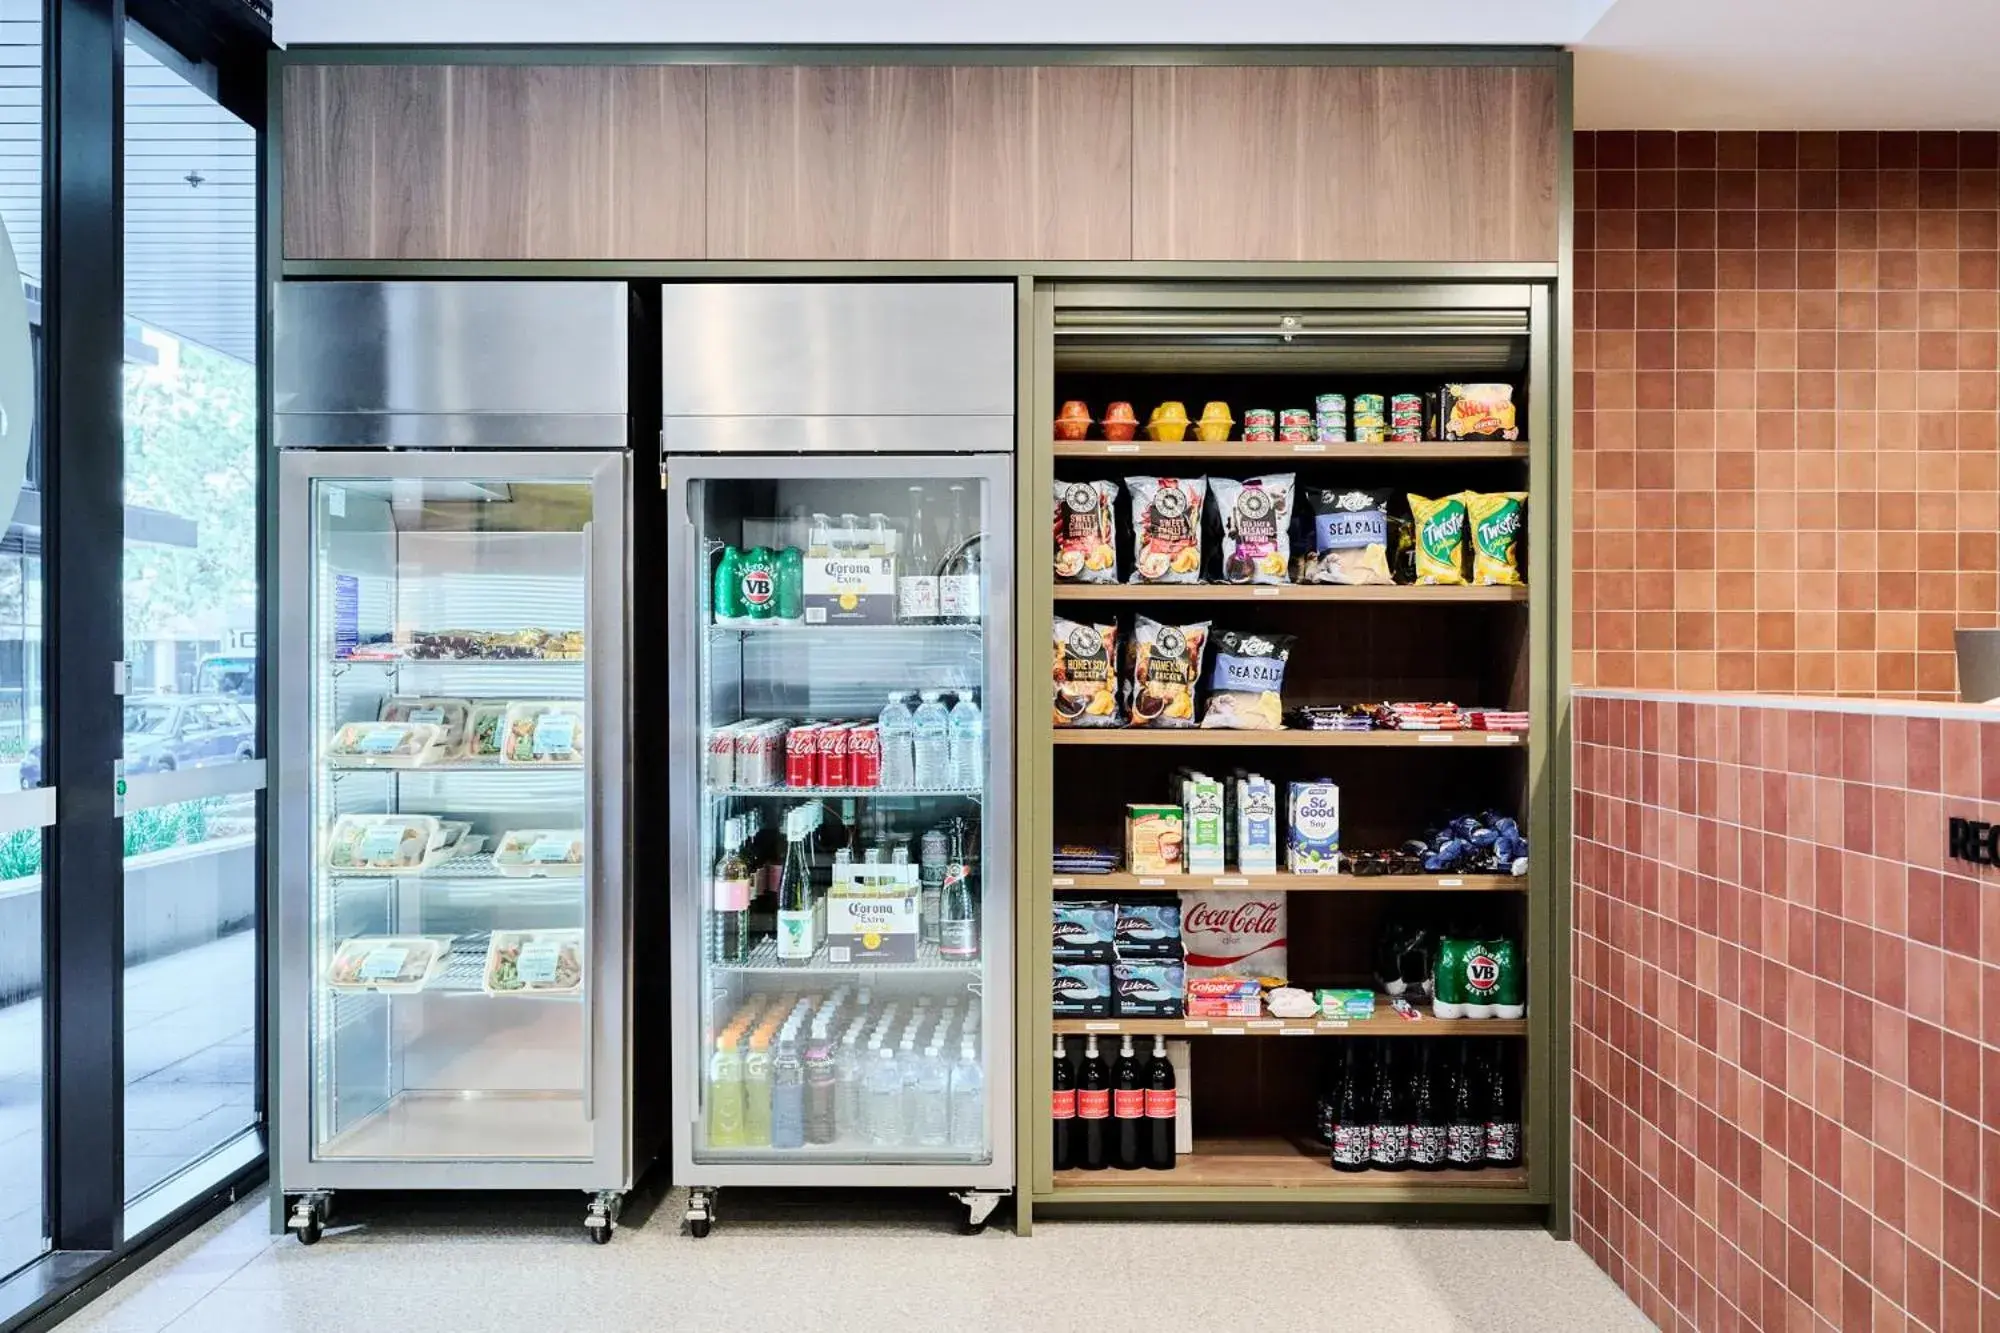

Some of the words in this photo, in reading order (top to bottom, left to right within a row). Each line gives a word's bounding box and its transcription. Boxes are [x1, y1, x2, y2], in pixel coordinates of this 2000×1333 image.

[1329, 522, 1353, 535] SEA
[824, 561, 872, 578] Corona
[746, 580, 770, 594] VB
[1228, 664, 1251, 678] SEA
[1253, 667, 1281, 682] SALT
[1310, 796, 1328, 808] So
[1300, 806, 1335, 818] Good
[848, 902, 894, 917] Corona
[1116, 918, 1153, 930] Libra
[1183, 901, 1282, 934] Coca-Cola
[1471, 965, 1495, 979] VB
[1121, 981, 1160, 991] Libra
[1189, 982, 1237, 994] Colgate
